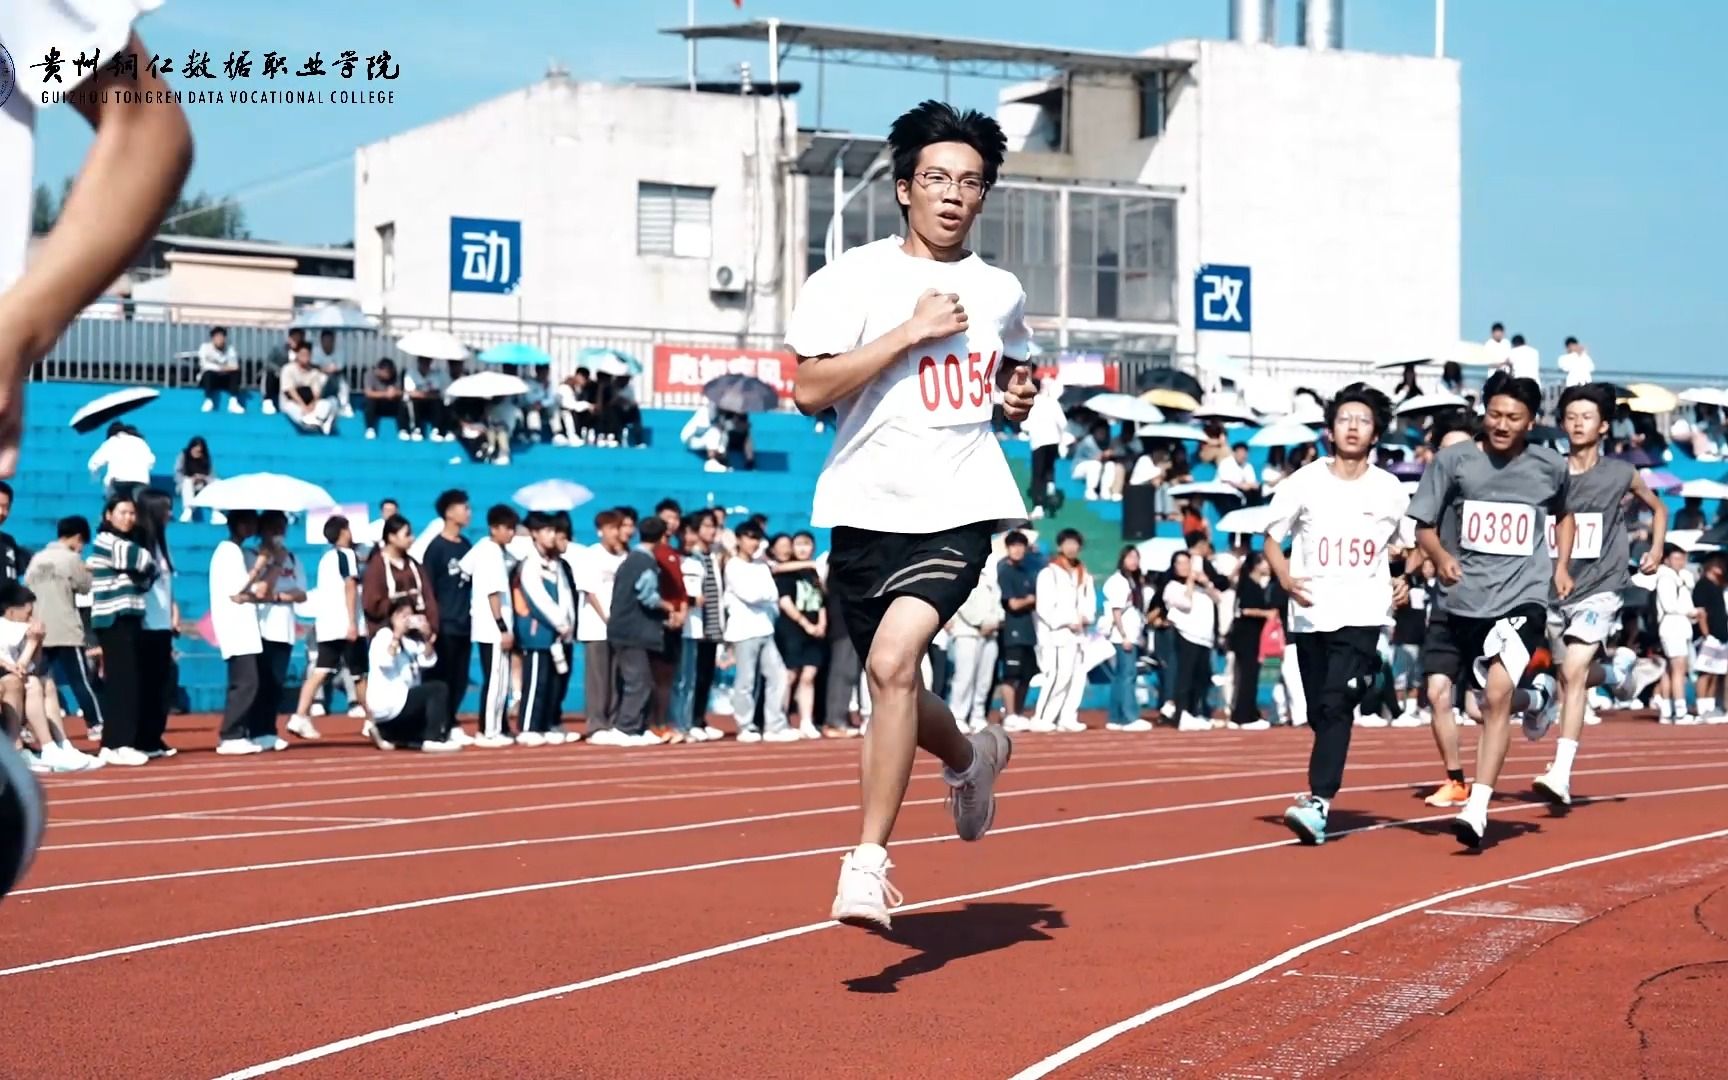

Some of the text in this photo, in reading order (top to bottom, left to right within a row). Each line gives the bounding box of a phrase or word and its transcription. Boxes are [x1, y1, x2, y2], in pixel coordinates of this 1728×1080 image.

[461, 229, 511, 284] 动
[1202, 274, 1244, 323] 改
[918, 350, 998, 412] 0054
[1467, 511, 1529, 545] 0380
[1548, 522, 1597, 550] 017
[1318, 536, 1376, 567] 0159
